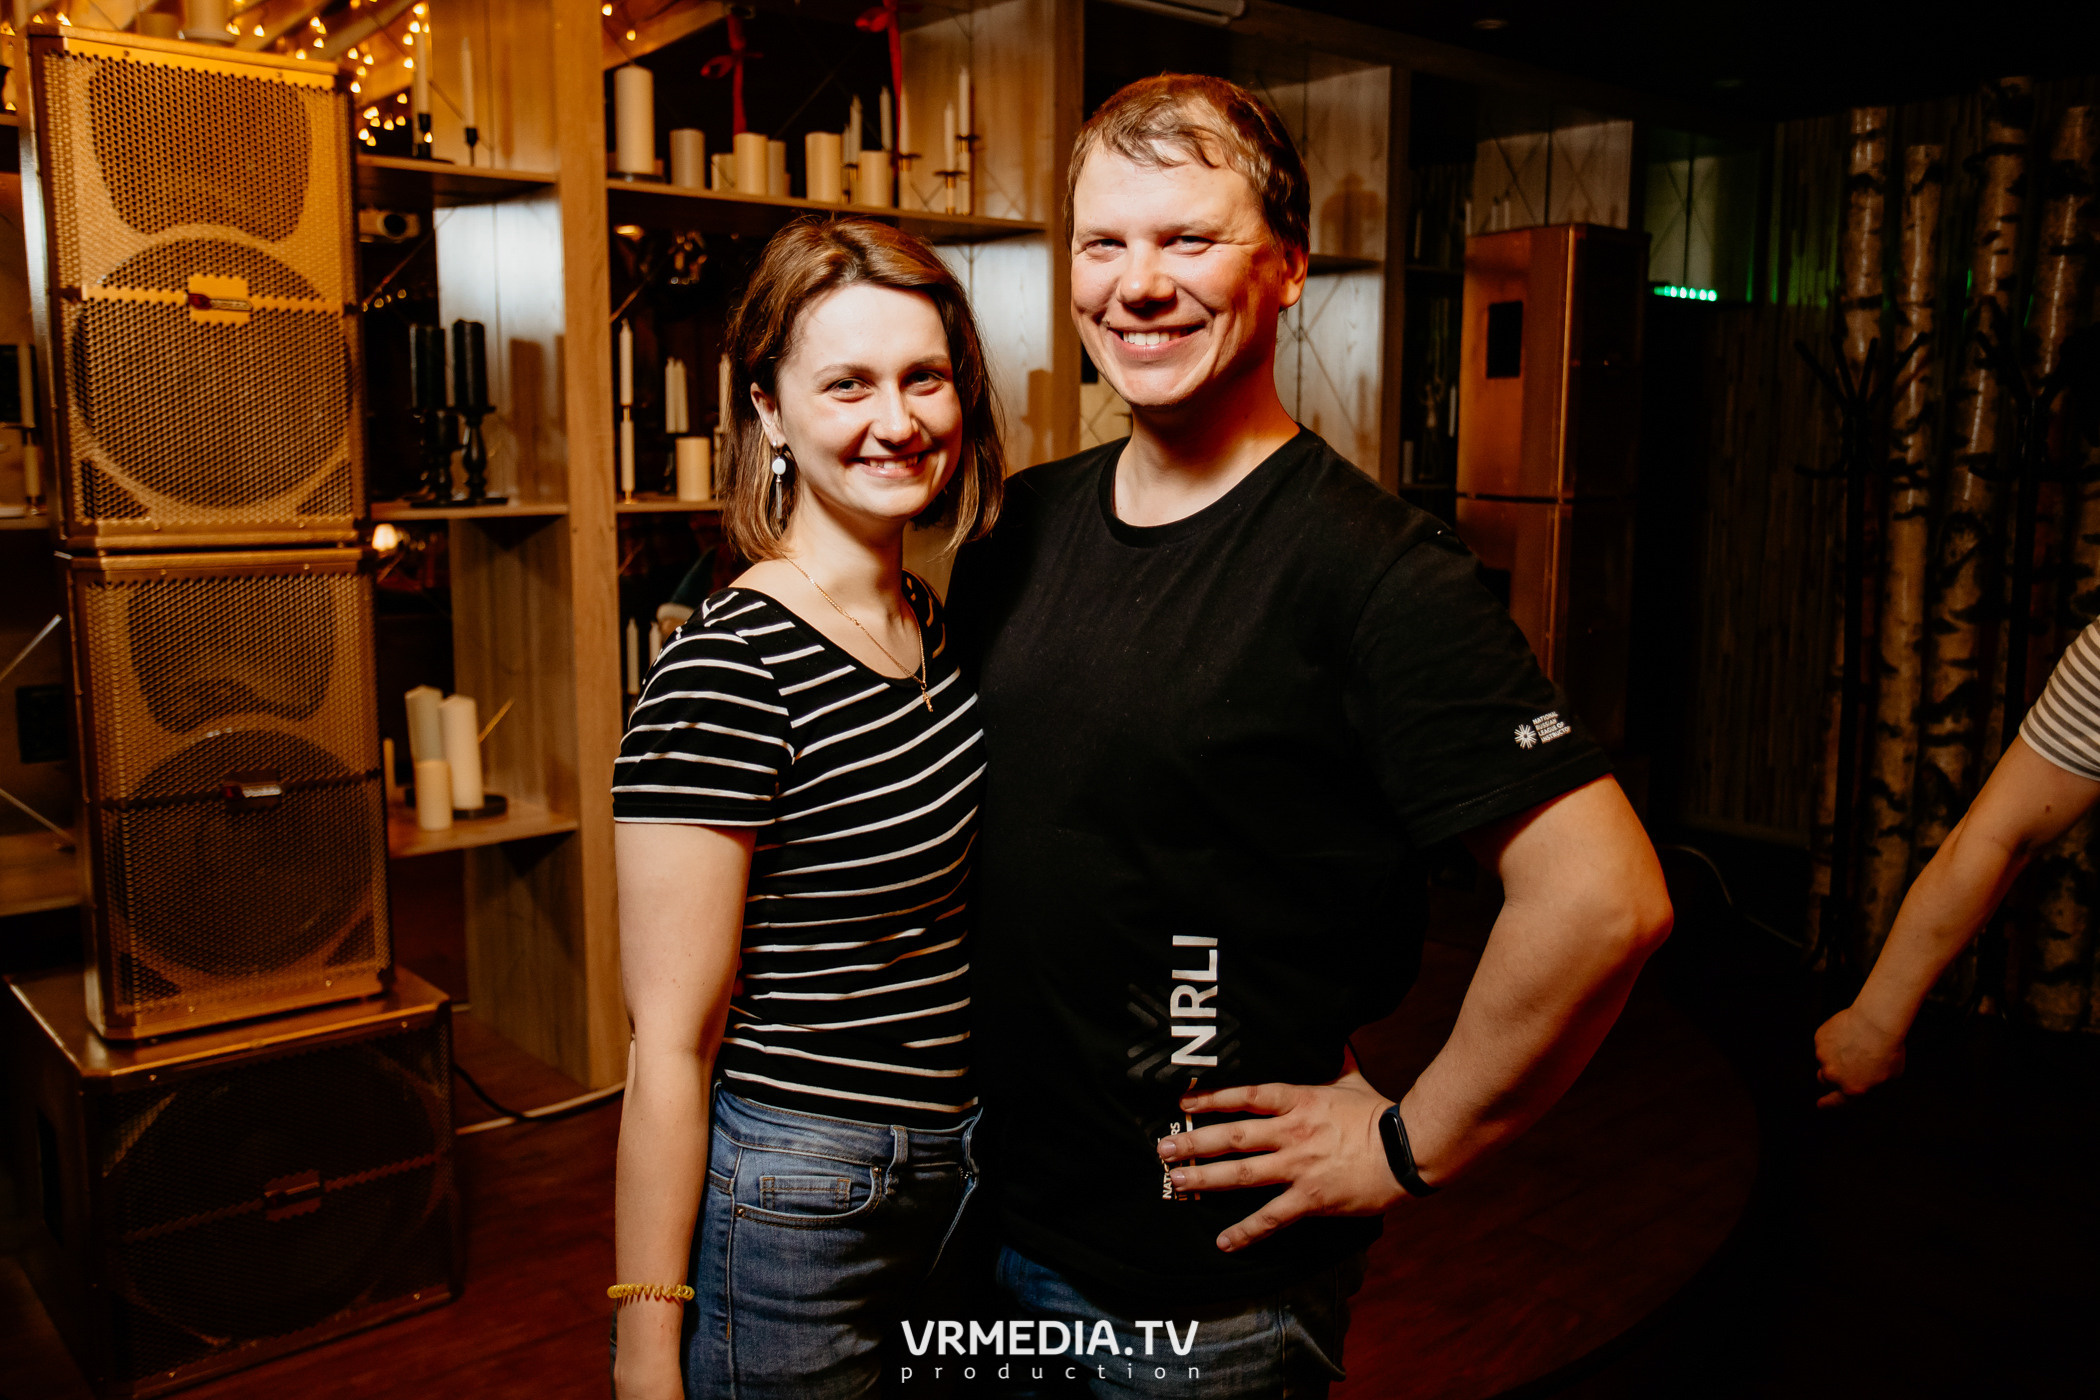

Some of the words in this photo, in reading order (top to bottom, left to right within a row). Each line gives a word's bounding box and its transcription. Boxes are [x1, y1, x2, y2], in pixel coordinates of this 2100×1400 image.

[1532, 711, 1559, 725] NATIONAL
[1535, 718, 1557, 731] RUSSIAN
[1538, 725, 1557, 738] LEAGUE
[1556, 721, 1565, 729] OF
[1170, 934, 1219, 1067] NRLI
